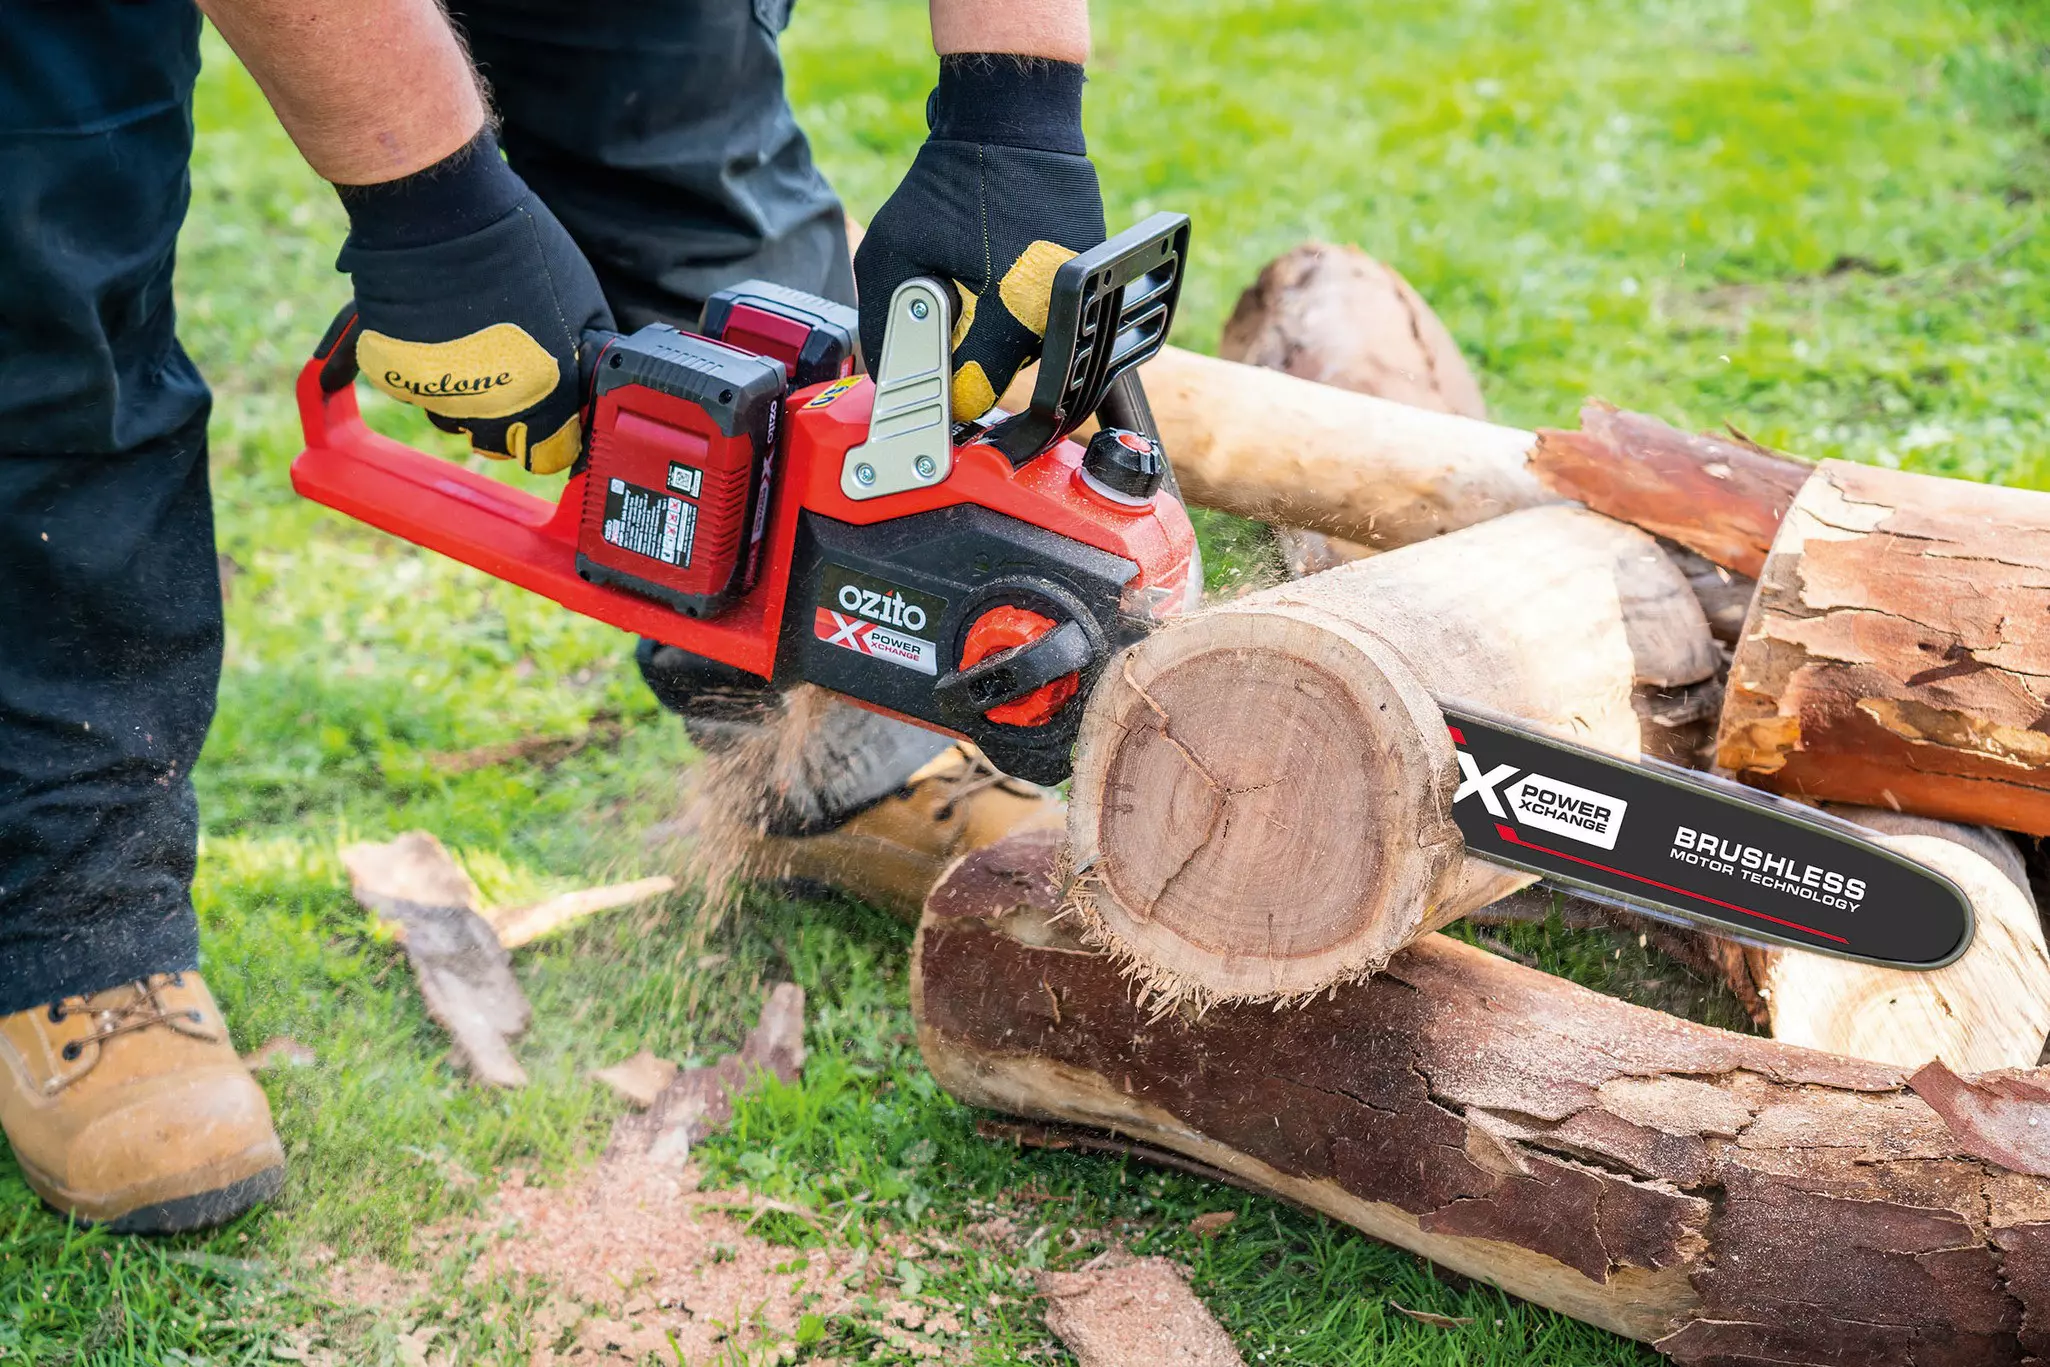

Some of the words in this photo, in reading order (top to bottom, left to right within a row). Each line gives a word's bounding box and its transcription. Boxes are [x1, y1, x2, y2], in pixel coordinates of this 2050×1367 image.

[384, 370, 513, 397] Cyclone
[766, 400, 778, 444] ozito
[838, 584, 927, 631] ozito
[870, 641, 920, 662] XCHANGE
[871, 632, 921, 655] POWER
[1518, 799, 1608, 834] XCHANGE
[1519, 783, 1613, 824] POWER
[1669, 847, 1734, 876] MOTOR
[1740, 868, 1861, 914] TECHNOLOGY
[1673, 826, 1868, 901] BRUSHLESS
